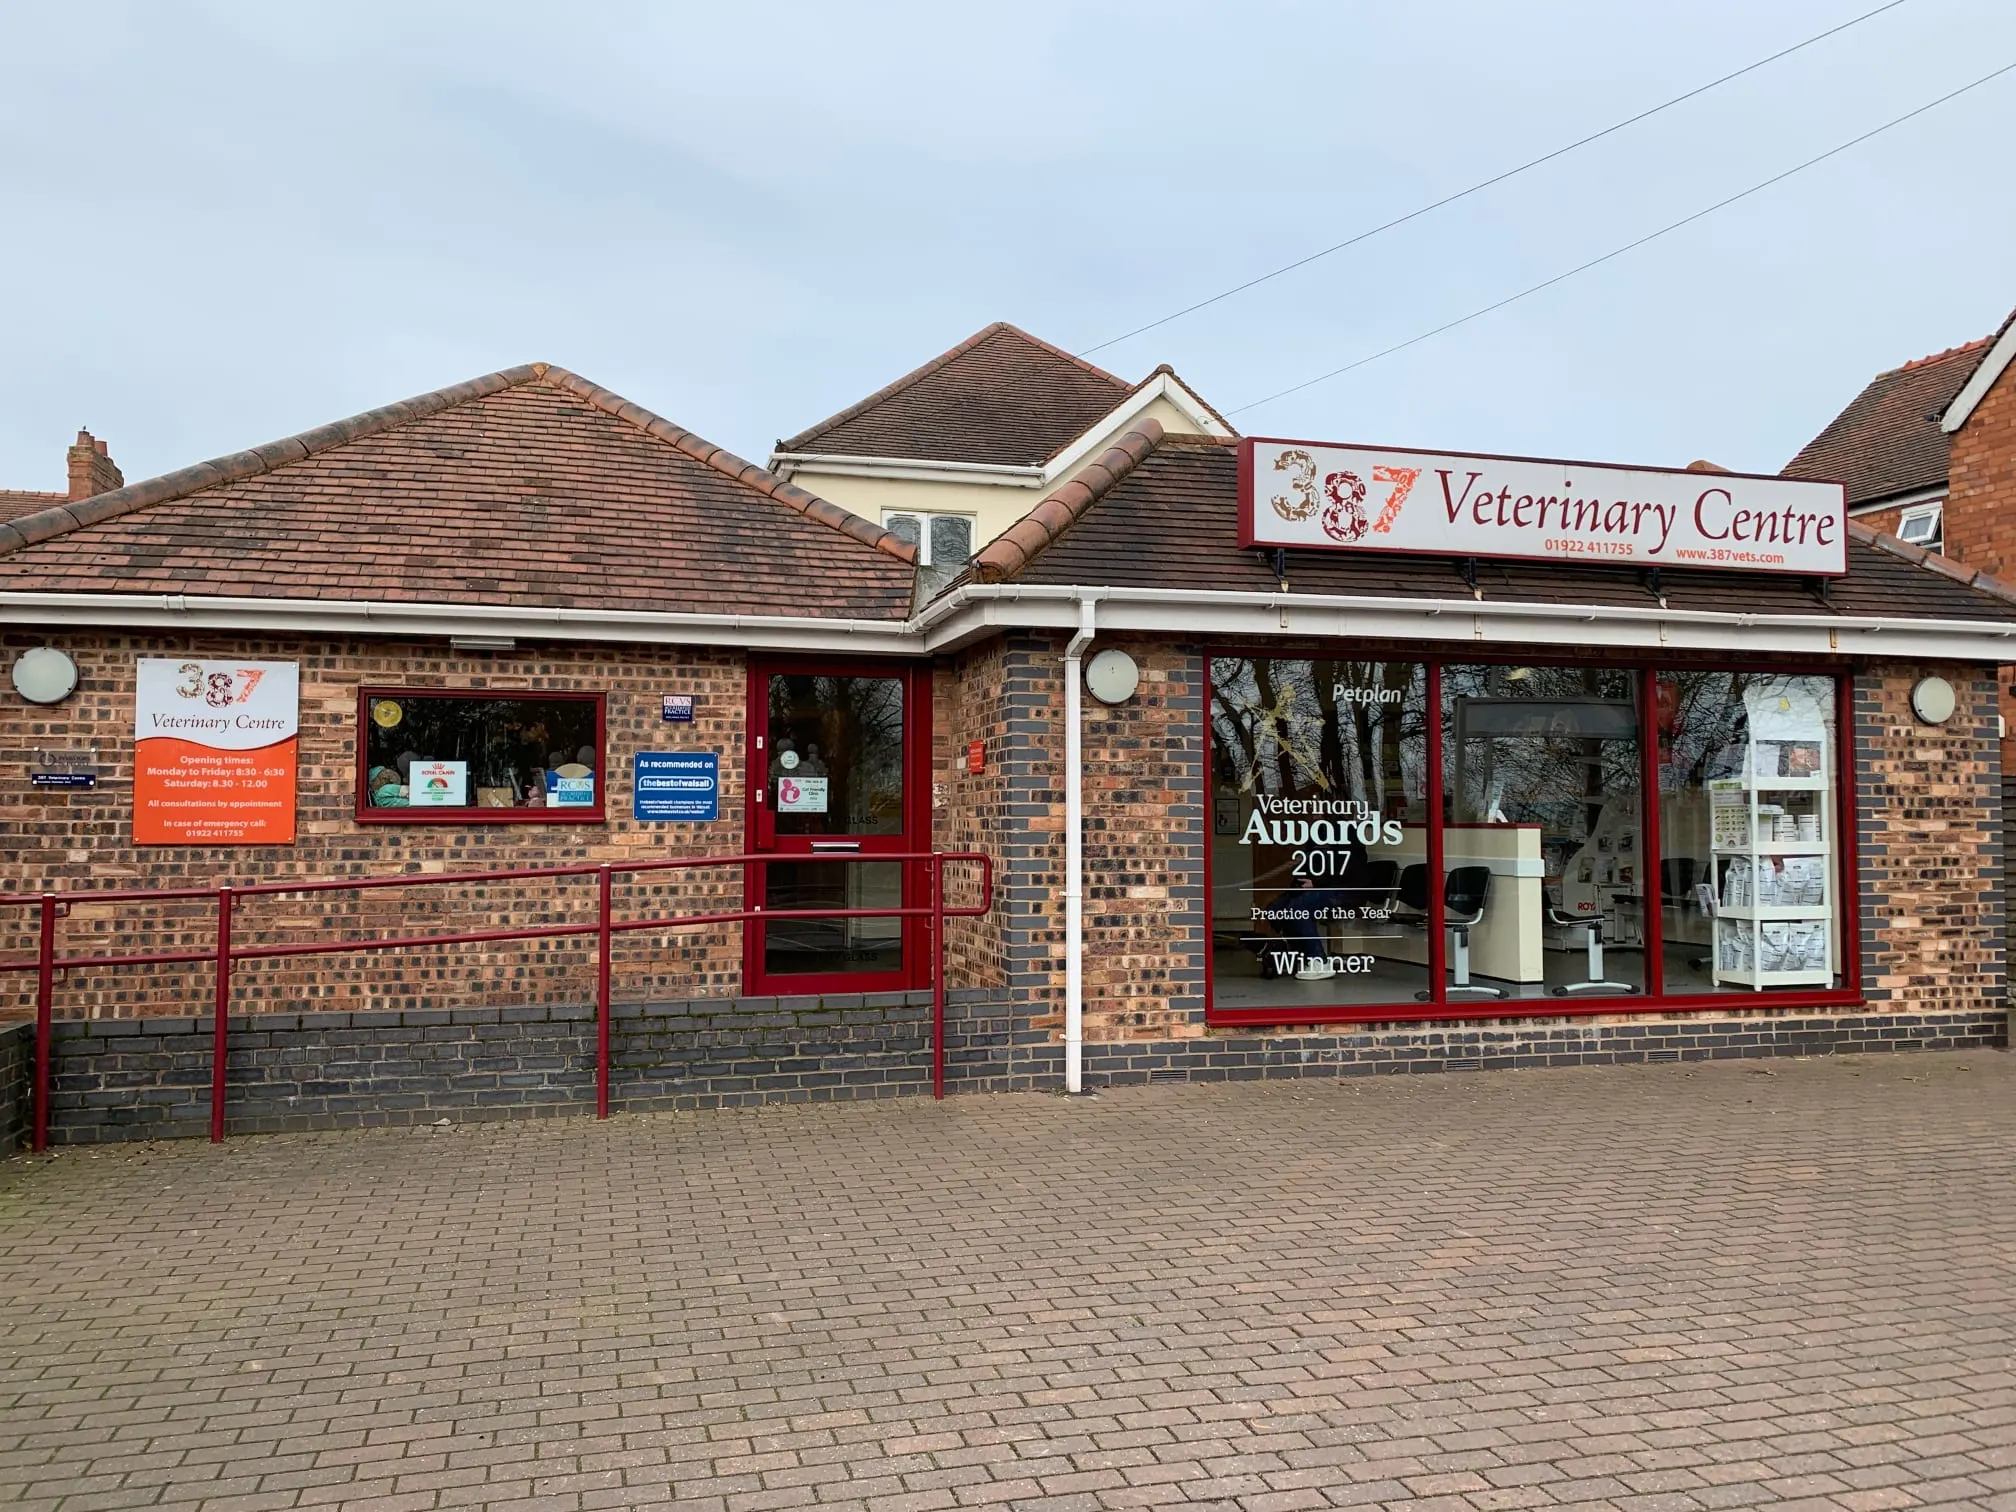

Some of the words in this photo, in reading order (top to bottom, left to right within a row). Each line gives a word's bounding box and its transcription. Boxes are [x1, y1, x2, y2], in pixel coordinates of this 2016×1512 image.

[1271, 449, 1423, 543] 387
[1434, 470, 1676, 555] Veterinary
[1694, 489, 1835, 546] Centre
[1545, 538, 1584, 553] 01922
[1587, 541, 1634, 555] 411755
[1676, 548, 1785, 565] www.387vets.com
[175, 663, 266, 709] 387
[1332, 684, 1402, 708] Petplan
[152, 713, 230, 733] Veterinary
[236, 714, 285, 730] Centre
[180, 755, 222, 765] Opening
[224, 756, 254, 764] times:
[640, 760, 649, 768] As
[651, 760, 702, 769] recommended
[147, 767, 188, 777] Monday
[202, 767, 235, 777] Friday:
[236, 768, 257, 776] 8:30
[264, 768, 285, 776] 6:30
[164, 779, 211, 789] Saturday:
[213, 780, 233, 788] 8.30
[242, 780, 268, 788] 12.00
[218, 800, 228, 809] by
[229, 801, 282, 809] appointment
[1256, 793, 1369, 820] Veterinary
[203, 821, 248, 829] emergency
[1239, 809, 1403, 846] Awards
[1291, 850, 1352, 876] 2017
[1250, 907, 1310, 921] Practice
[1314, 907, 1329, 920] of
[1332, 907, 1356, 920] the
[1359, 906, 1393, 920] Year
[1577, 902, 1596, 911] ROY
[1270, 951, 1375, 975] Winner
